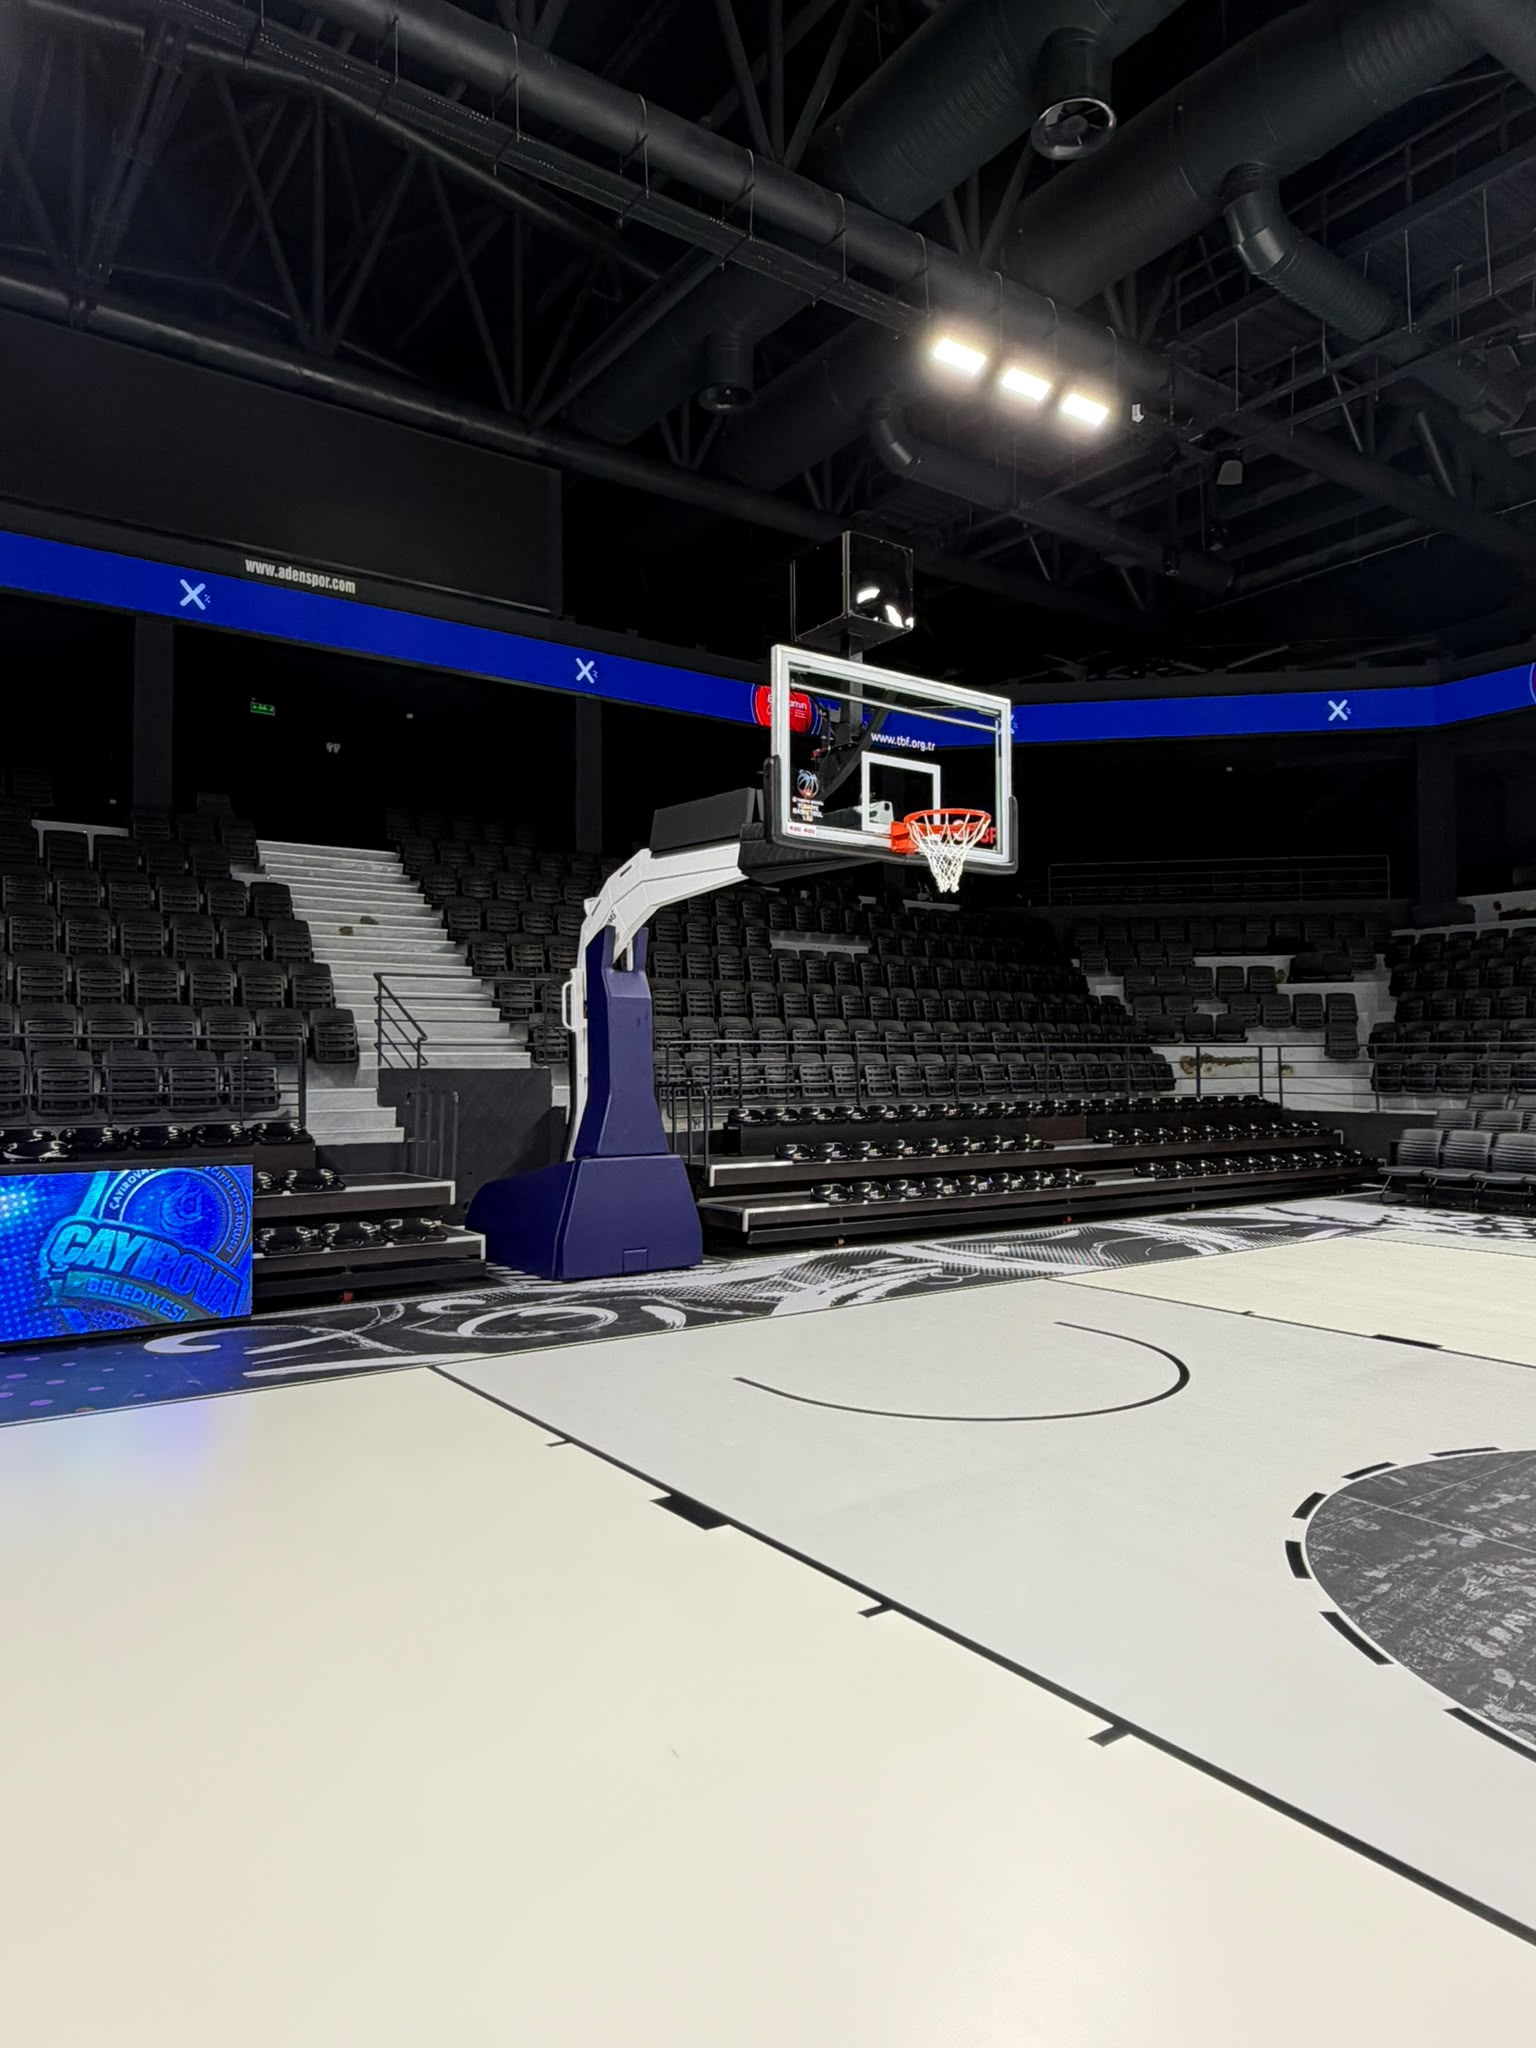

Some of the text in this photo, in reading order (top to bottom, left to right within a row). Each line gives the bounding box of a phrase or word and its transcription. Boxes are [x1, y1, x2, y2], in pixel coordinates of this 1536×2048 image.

[244, 559, 356, 594] www.adenspor.com
[870, 732, 936, 752] www.tbf.org.tr
[49, 1224, 240, 1318] ÇAYIROVA
